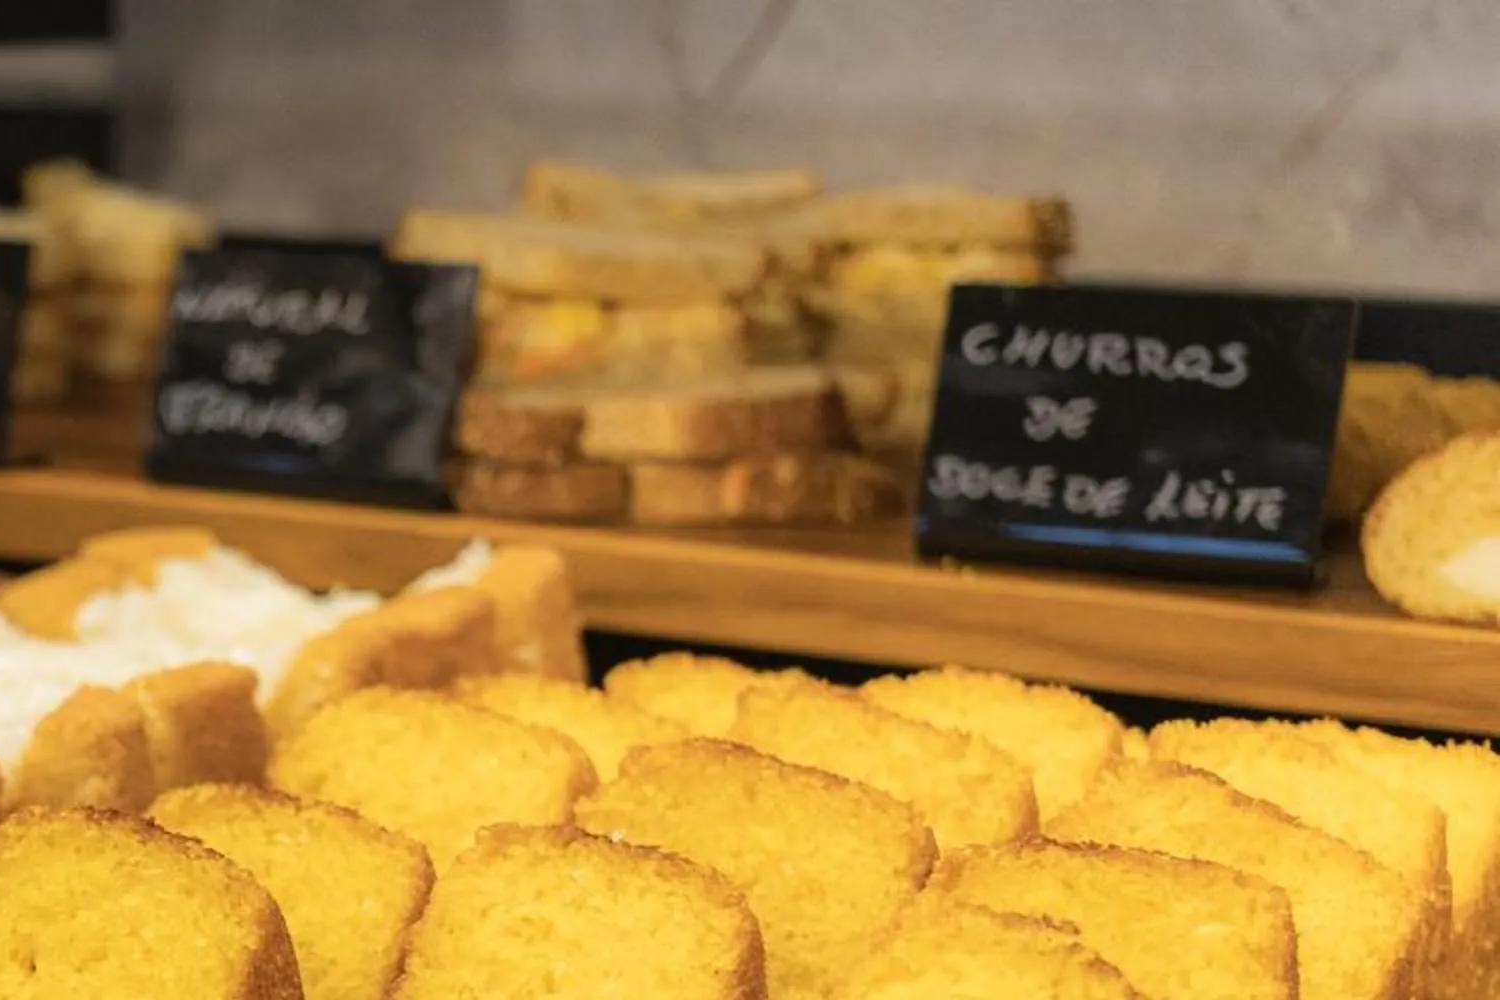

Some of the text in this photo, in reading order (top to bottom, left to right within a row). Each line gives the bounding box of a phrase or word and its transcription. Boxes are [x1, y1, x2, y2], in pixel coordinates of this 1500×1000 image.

[961, 322, 1249, 388] CHURROS
[1022, 397, 1097, 441] DE
[1063, 474, 1130, 518] DE
